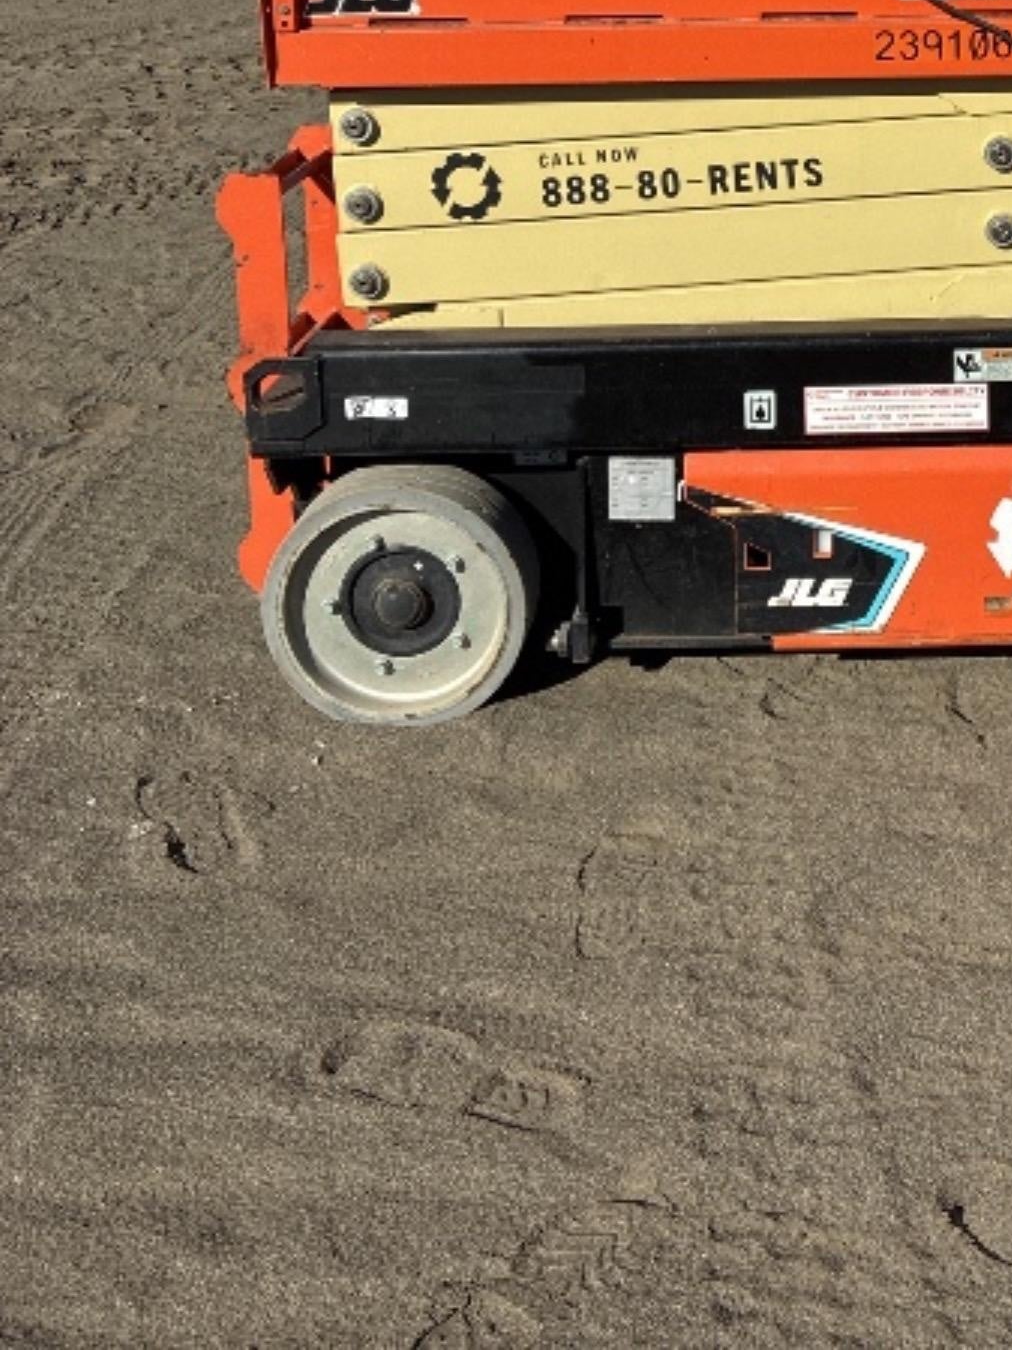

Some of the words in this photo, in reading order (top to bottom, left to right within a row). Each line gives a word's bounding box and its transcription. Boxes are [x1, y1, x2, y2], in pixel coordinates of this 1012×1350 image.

[875, 27, 1012, 61] 239106
[538, 151, 587, 169] CALL
[596, 146, 640, 165] NOW
[541, 158, 824, 208] 888-80-RENTS
[767, 577, 853, 607] JLG
